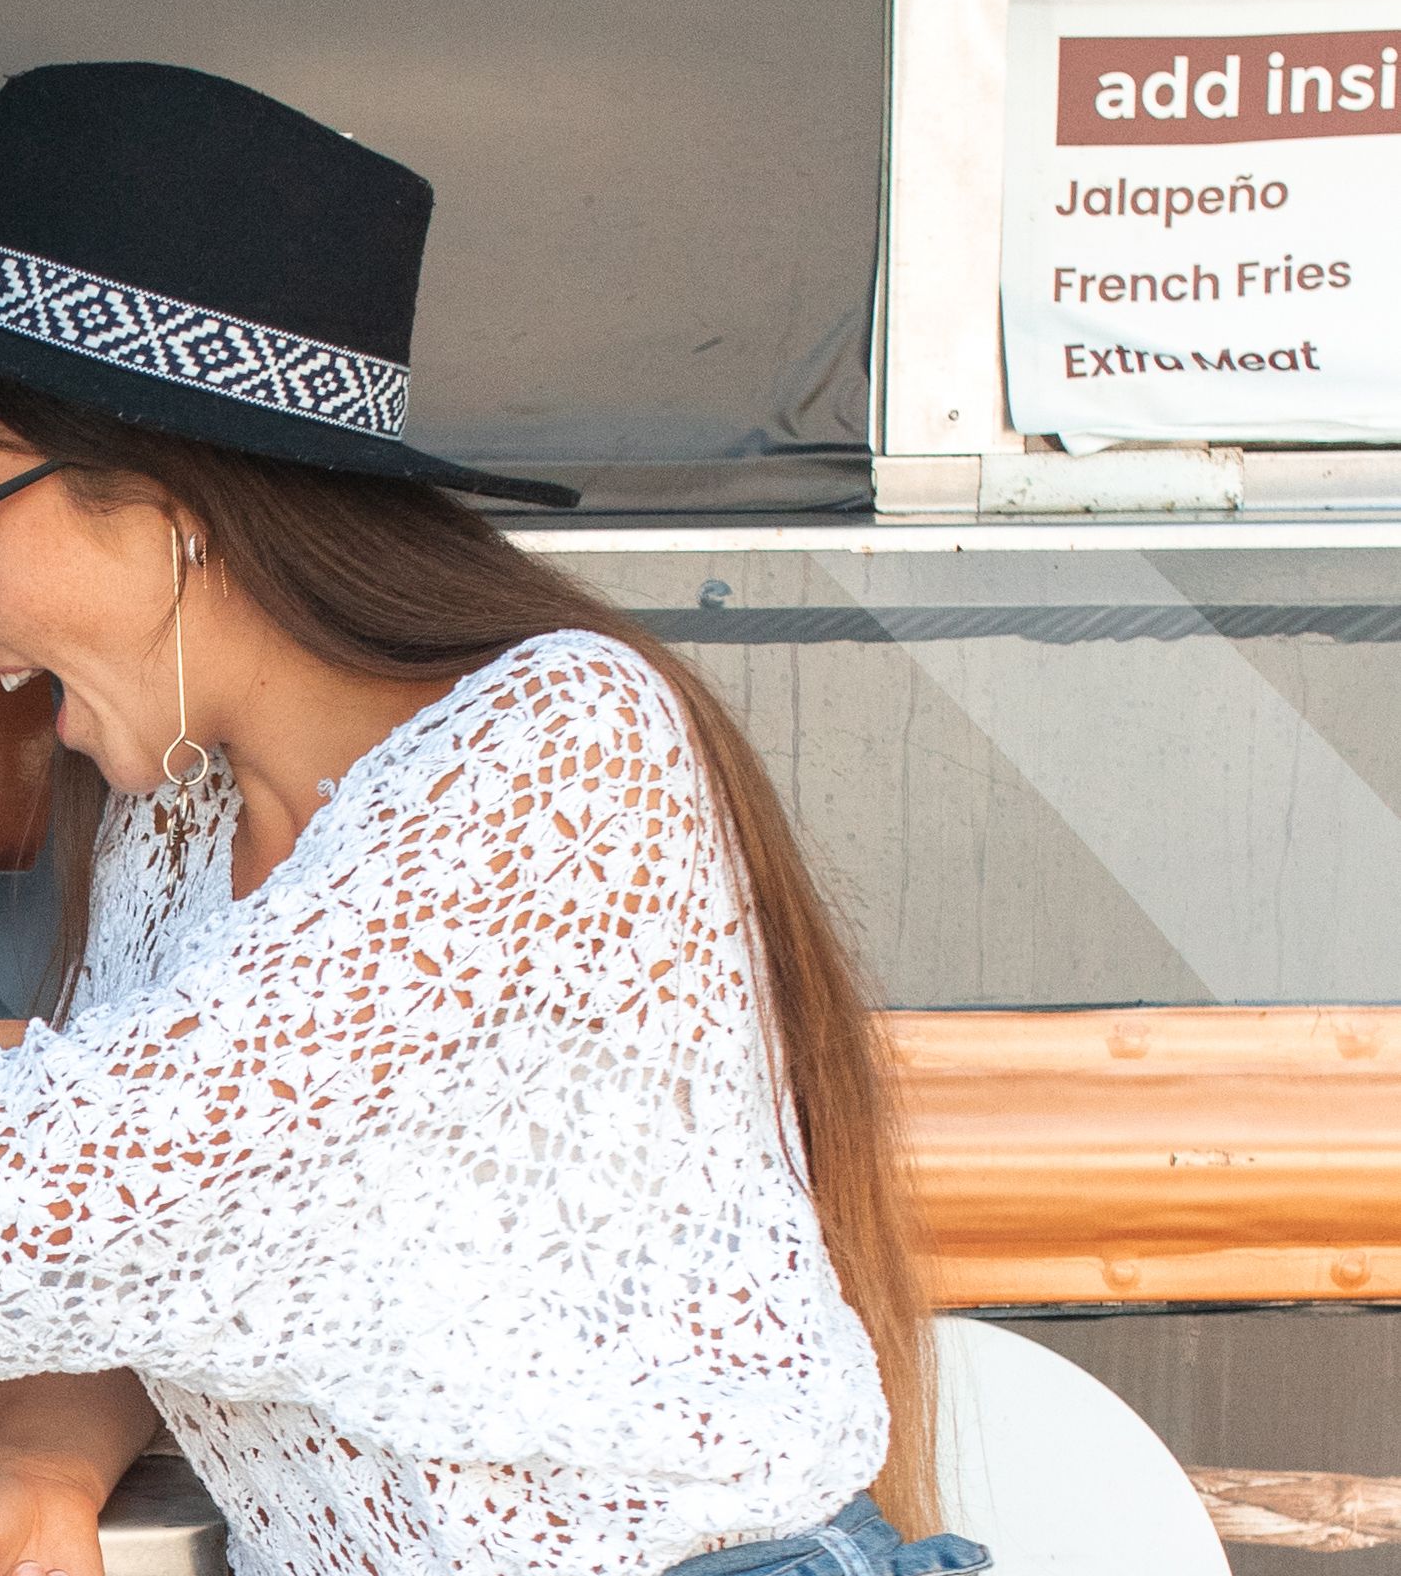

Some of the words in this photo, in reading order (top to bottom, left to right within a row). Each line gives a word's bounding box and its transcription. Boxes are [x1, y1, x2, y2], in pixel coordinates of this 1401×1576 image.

[1095, 54, 1241, 120] add
[1267, 46, 1398, 115] insi
[1056, 174, 1289, 228] Jalapeño
[1054, 264, 1220, 303] French
[1237, 254, 1351, 297] Fries
[1064, 343, 1185, 379] Extra
[1191, 340, 1320, 372] Meat
